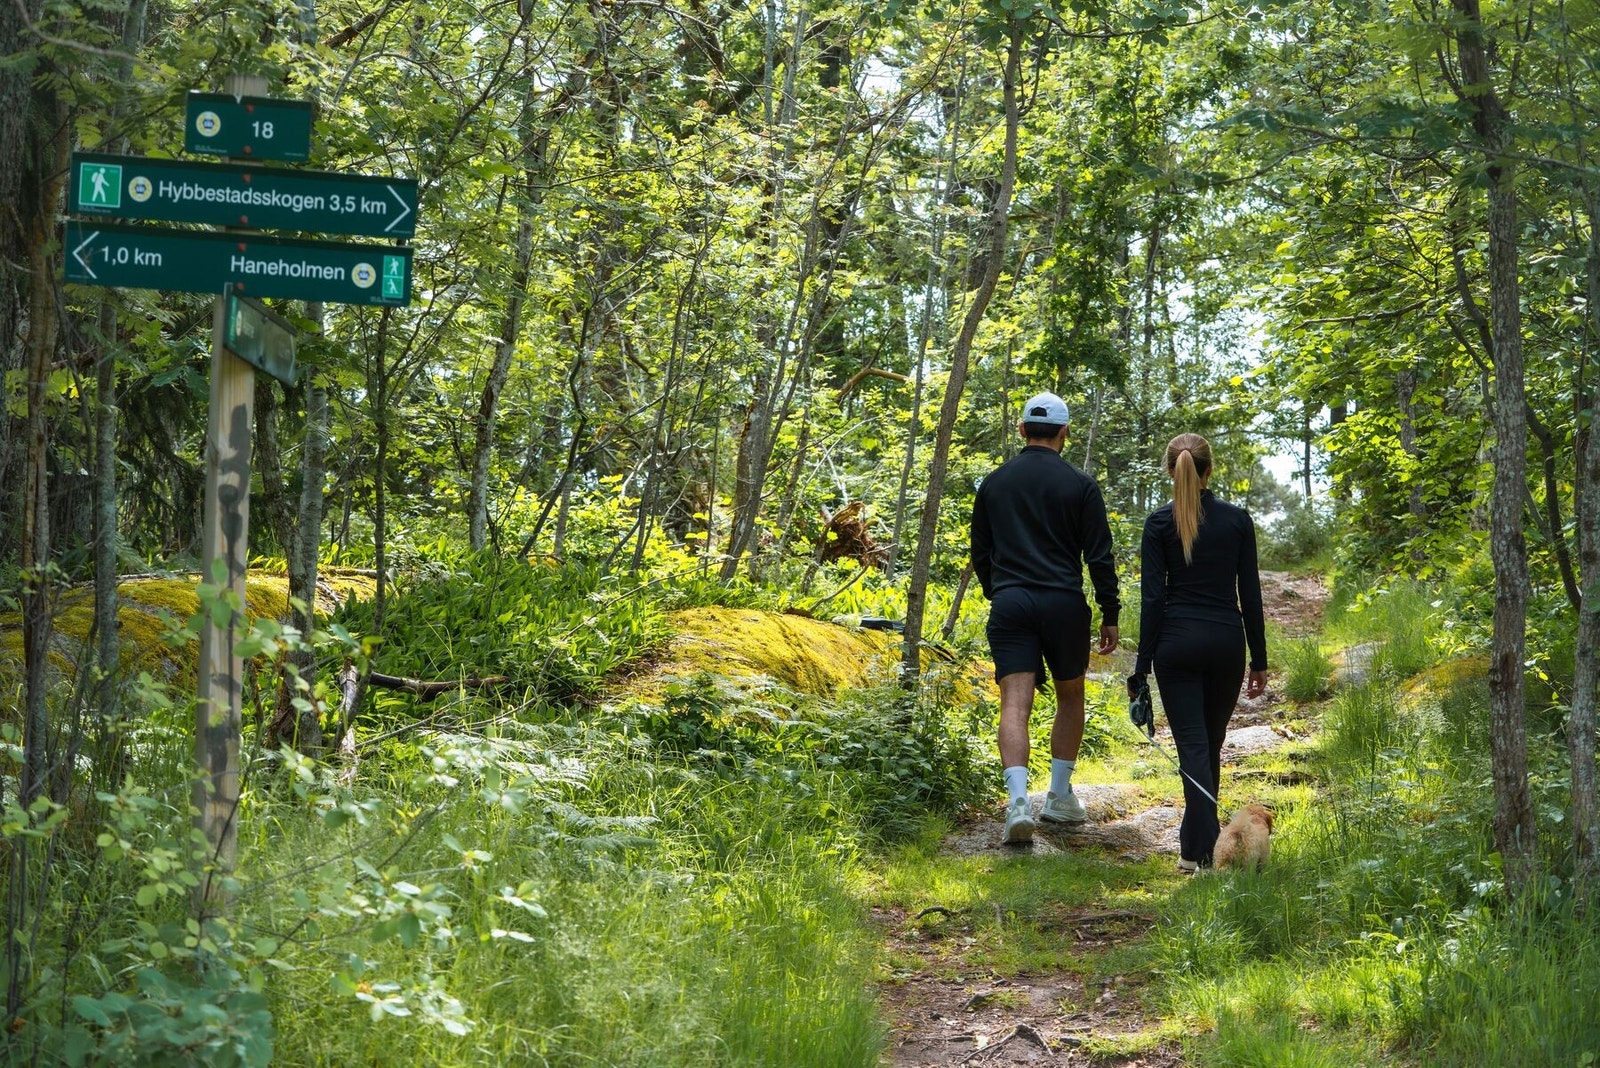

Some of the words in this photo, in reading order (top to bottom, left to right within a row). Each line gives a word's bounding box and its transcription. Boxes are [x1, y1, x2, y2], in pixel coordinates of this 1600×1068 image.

[252, 120, 274, 139] 18
[158, 180, 325, 213] Hybbestadsskogen
[329, 194, 356, 214] 3,5
[361, 196, 387, 215] km
[102, 245, 128, 266] 1,0
[133, 247, 162, 266] km
[230, 255, 345, 281] Haneholmen
